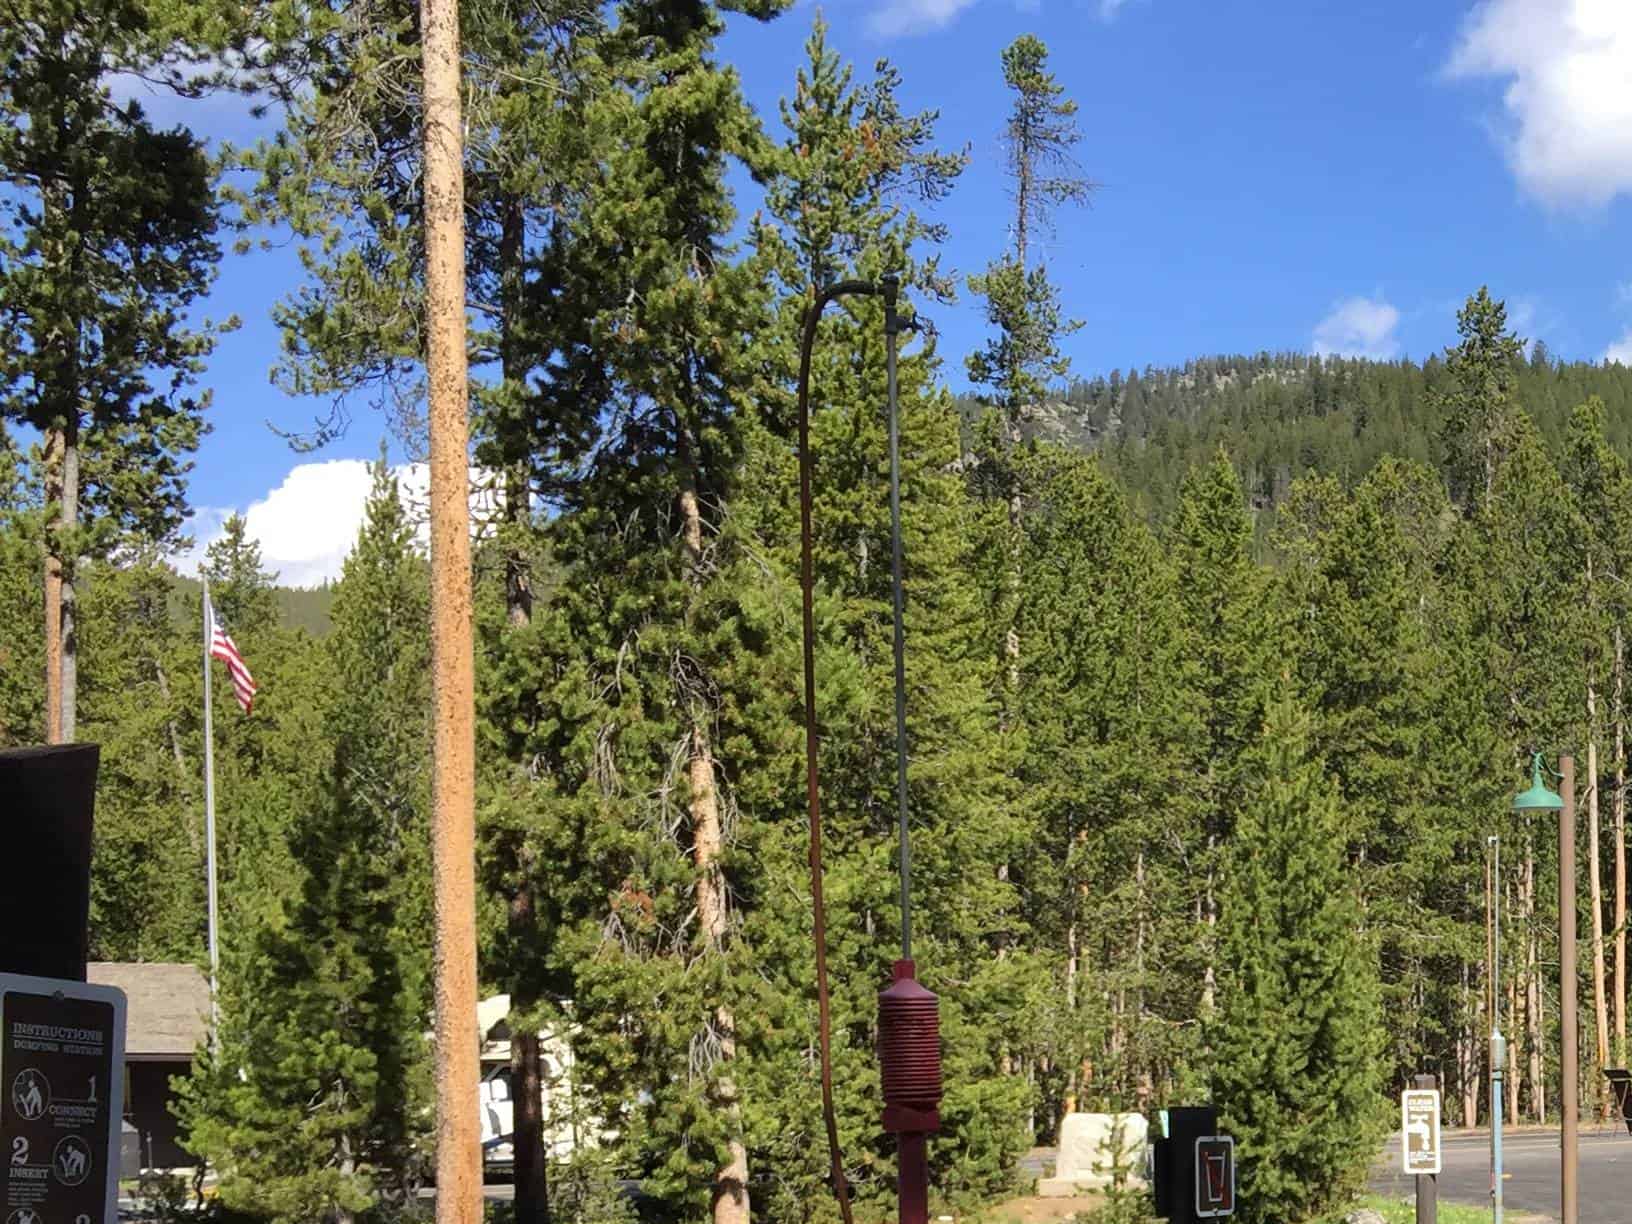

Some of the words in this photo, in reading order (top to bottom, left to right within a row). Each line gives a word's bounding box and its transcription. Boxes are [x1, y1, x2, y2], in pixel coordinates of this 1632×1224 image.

[13, 1023, 103, 1041] INSTRUCTIONS
[63, 1044, 103, 1056] STATION
[88, 1075, 97, 1103] 1
[49, 1104, 96, 1117] CONNECT
[10, 1136, 28, 1166] 2
[9, 1167, 48, 1179] INSERT
